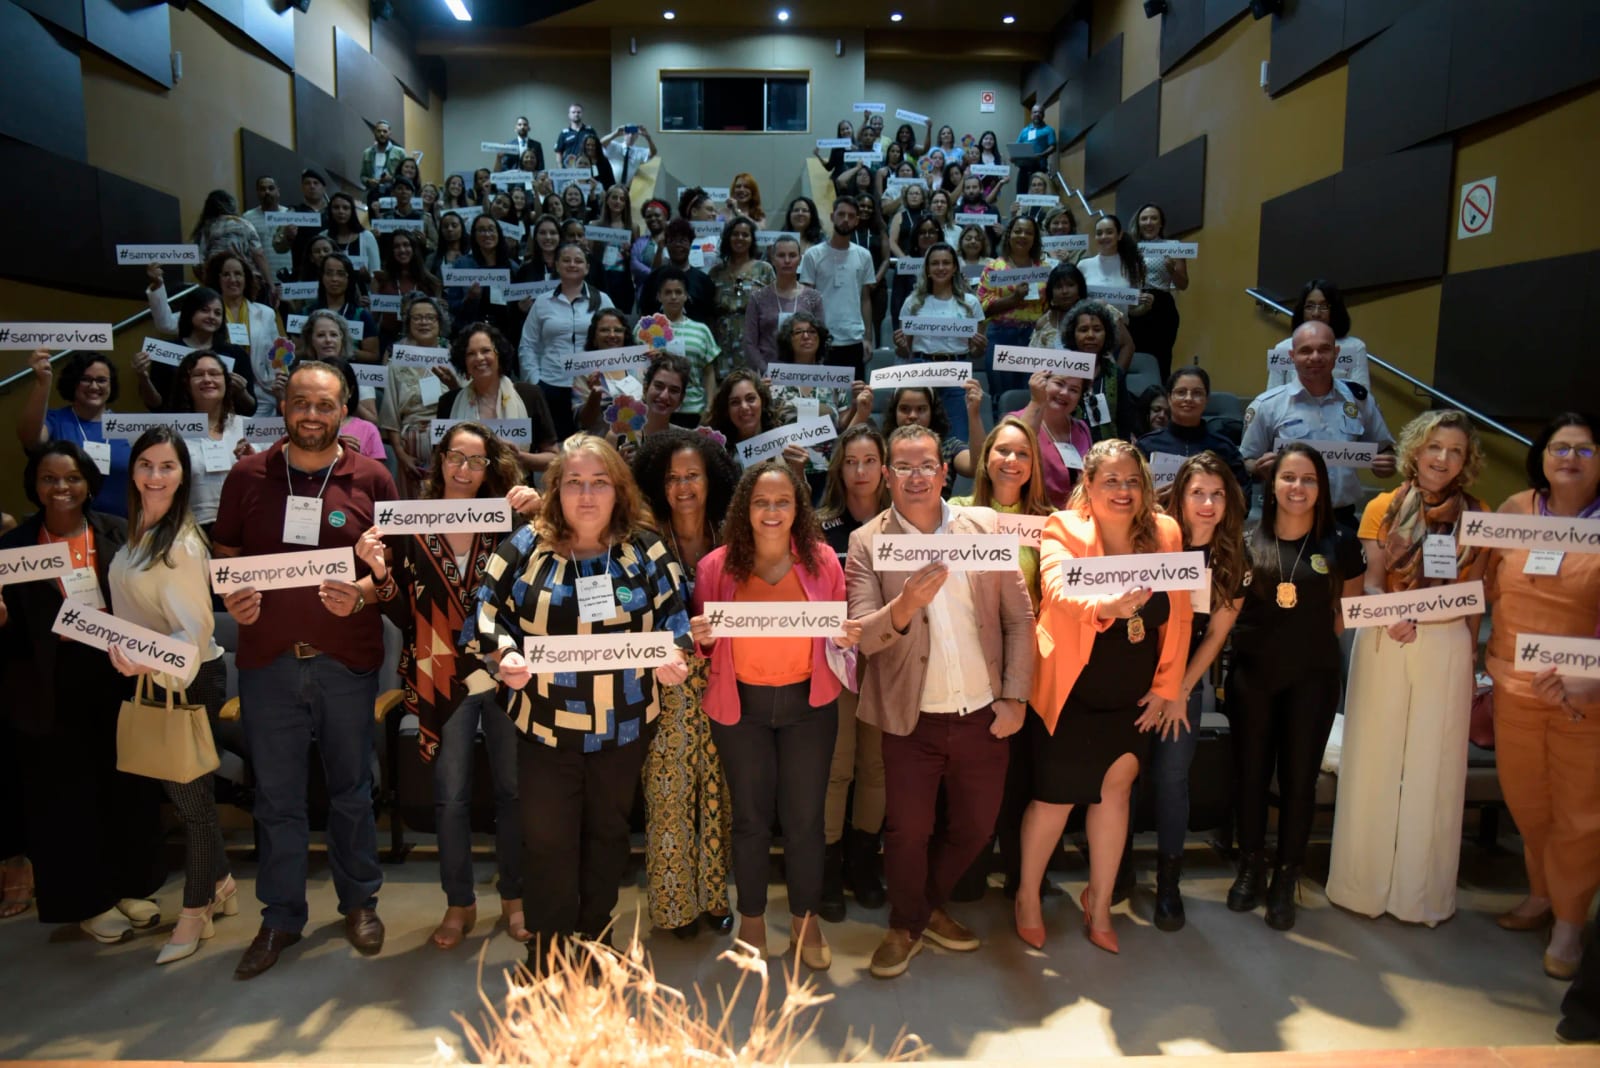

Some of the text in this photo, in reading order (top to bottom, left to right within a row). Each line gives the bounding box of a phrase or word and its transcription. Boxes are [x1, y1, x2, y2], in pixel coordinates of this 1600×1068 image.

[120, 249, 196, 261] #semprevivas
[445, 272, 508, 283] #semprevivas
[0, 328, 108, 345] #semprevivas
[904, 320, 975, 334] #semprevivas
[396, 350, 451, 365] #semprev
[564, 353, 648, 371] #semprevivas
[997, 351, 1091, 373] #semprevivas
[770, 368, 851, 384] #semprevivas
[875, 367, 969, 382] #semprevivas
[743, 424, 831, 459] #semprevivas
[379, 508, 506, 528] #semprevivas
[822, 517, 844, 530] CIVIL
[1466, 519, 1600, 546] #sempreviva
[0, 554, 65, 577] evivas
[878, 542, 1012, 567] #semprevivas
[215, 559, 349, 585] #semprevivas
[1067, 562, 1200, 588] #semprevivas
[1347, 591, 1478, 620] #semprevivas
[709, 608, 841, 632] #semprevivas
[60, 607, 187, 669] #semprevivas
[529, 643, 668, 666] #semprevivas
